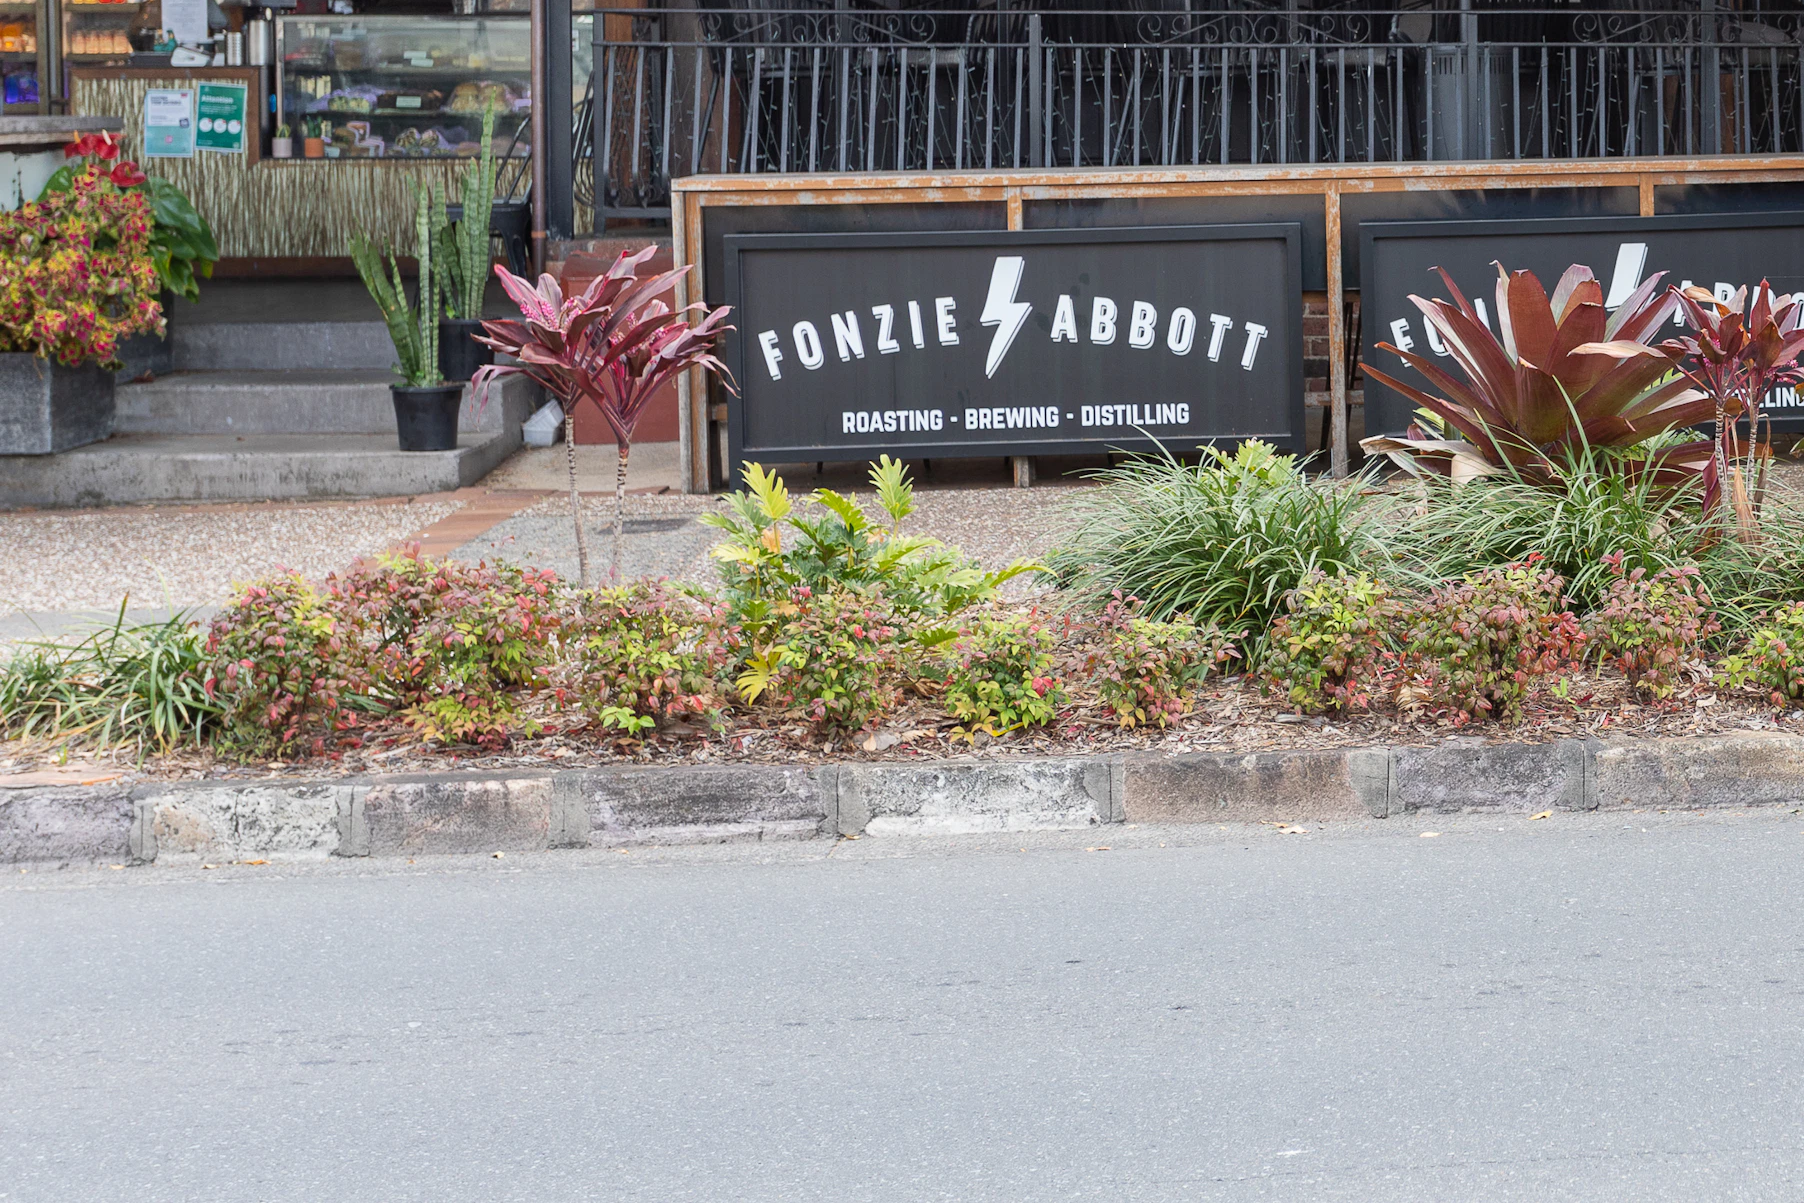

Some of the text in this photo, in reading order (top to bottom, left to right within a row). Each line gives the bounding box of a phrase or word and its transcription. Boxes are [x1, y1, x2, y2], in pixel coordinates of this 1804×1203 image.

[758, 294, 1268, 380] FONZIE ABBOTT
[842, 410, 942, 433] ROASTING
[965, 406, 1059, 430] BREWING
[1081, 403, 1190, 427] DISTILLING
